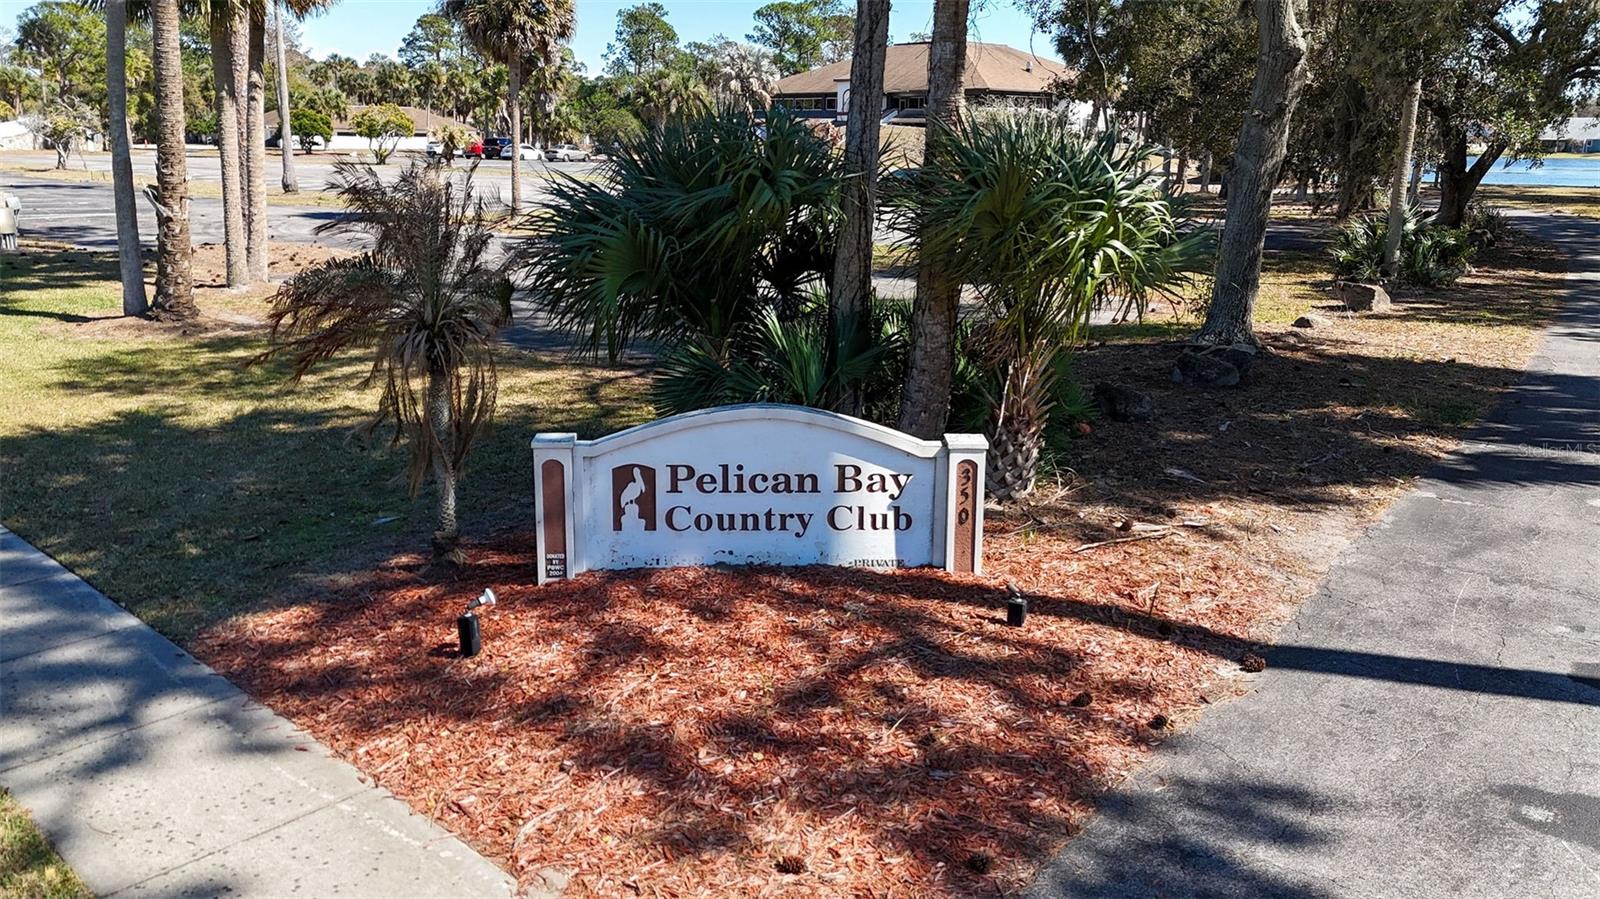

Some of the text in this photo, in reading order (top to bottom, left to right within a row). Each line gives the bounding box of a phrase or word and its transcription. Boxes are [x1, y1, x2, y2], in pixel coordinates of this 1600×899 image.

[665, 464, 913, 500] Pelican Bay
[958, 468, 971, 526] 350
[664, 505, 913, 538] Country Club
[854, 558, 905, 568] PRIVATE
